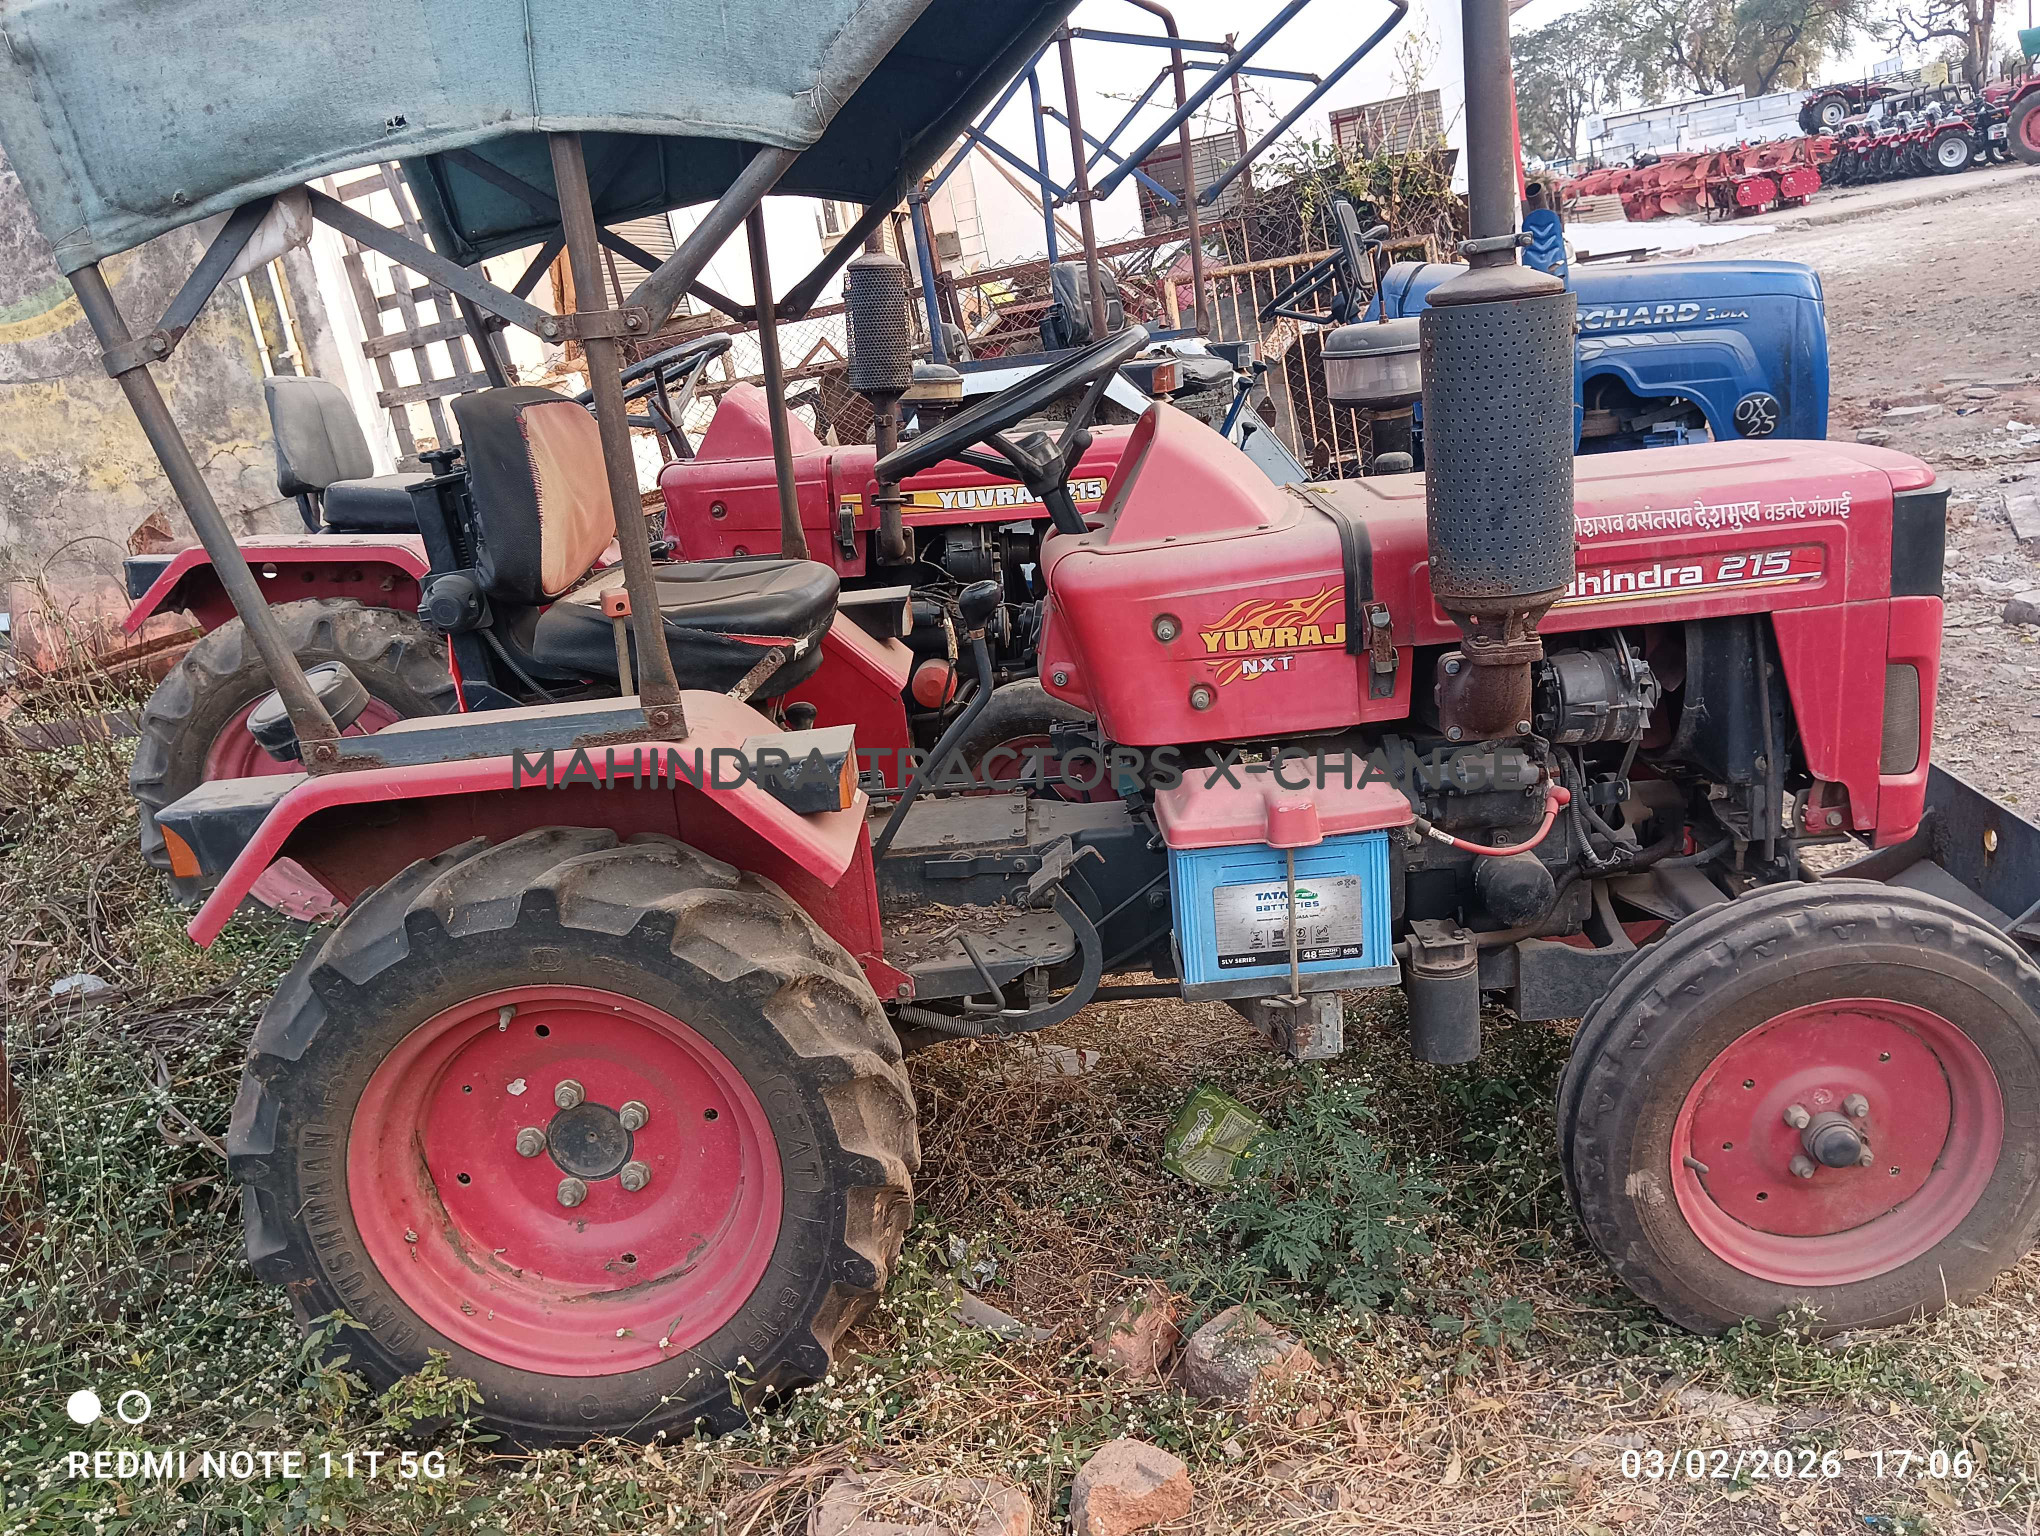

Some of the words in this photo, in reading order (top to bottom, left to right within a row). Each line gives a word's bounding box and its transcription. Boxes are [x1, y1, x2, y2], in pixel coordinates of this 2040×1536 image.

[1736, 398, 1770, 421] OX
[1746, 416, 1776, 437] 25
[937, 485, 1042, 509] YUVRA
[1627, 505, 1693, 531] वसंतराव
[1694, 500, 1761, 532] देशमुख
[1808, 491, 1852, 519] गंगाई
[1716, 550, 1792, 581] 215
[1199, 623, 1346, 654] YUVRAJ
[1241, 656, 1294, 675] NXT
[1255, 890, 1288, 901] TATA
[1235, 956, 1256, 964] SERIES
[1303, 950, 1318, 959] 48
